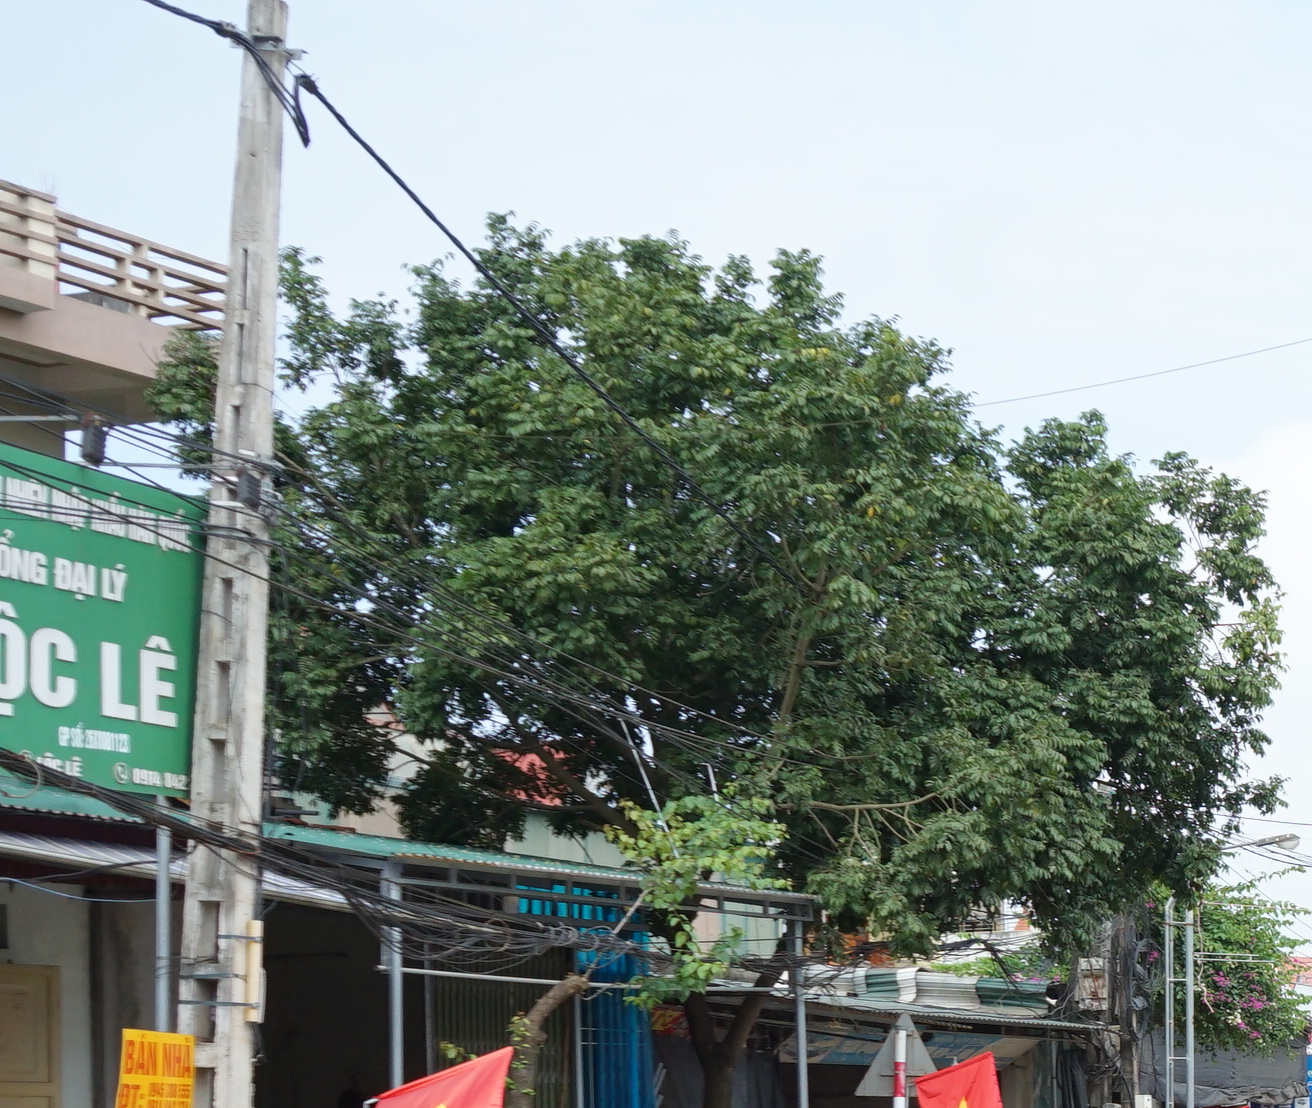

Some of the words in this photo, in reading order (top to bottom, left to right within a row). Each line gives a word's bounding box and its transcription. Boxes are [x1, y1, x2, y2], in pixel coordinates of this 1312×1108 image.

[54, 556, 97, 600] ĐẠI
[101, 563, 129, 602] LÝ
[100, 635, 178, 728] LÊ
[123, 1034, 157, 1076] BÁN
[162, 1037, 192, 1078] NHÀ
